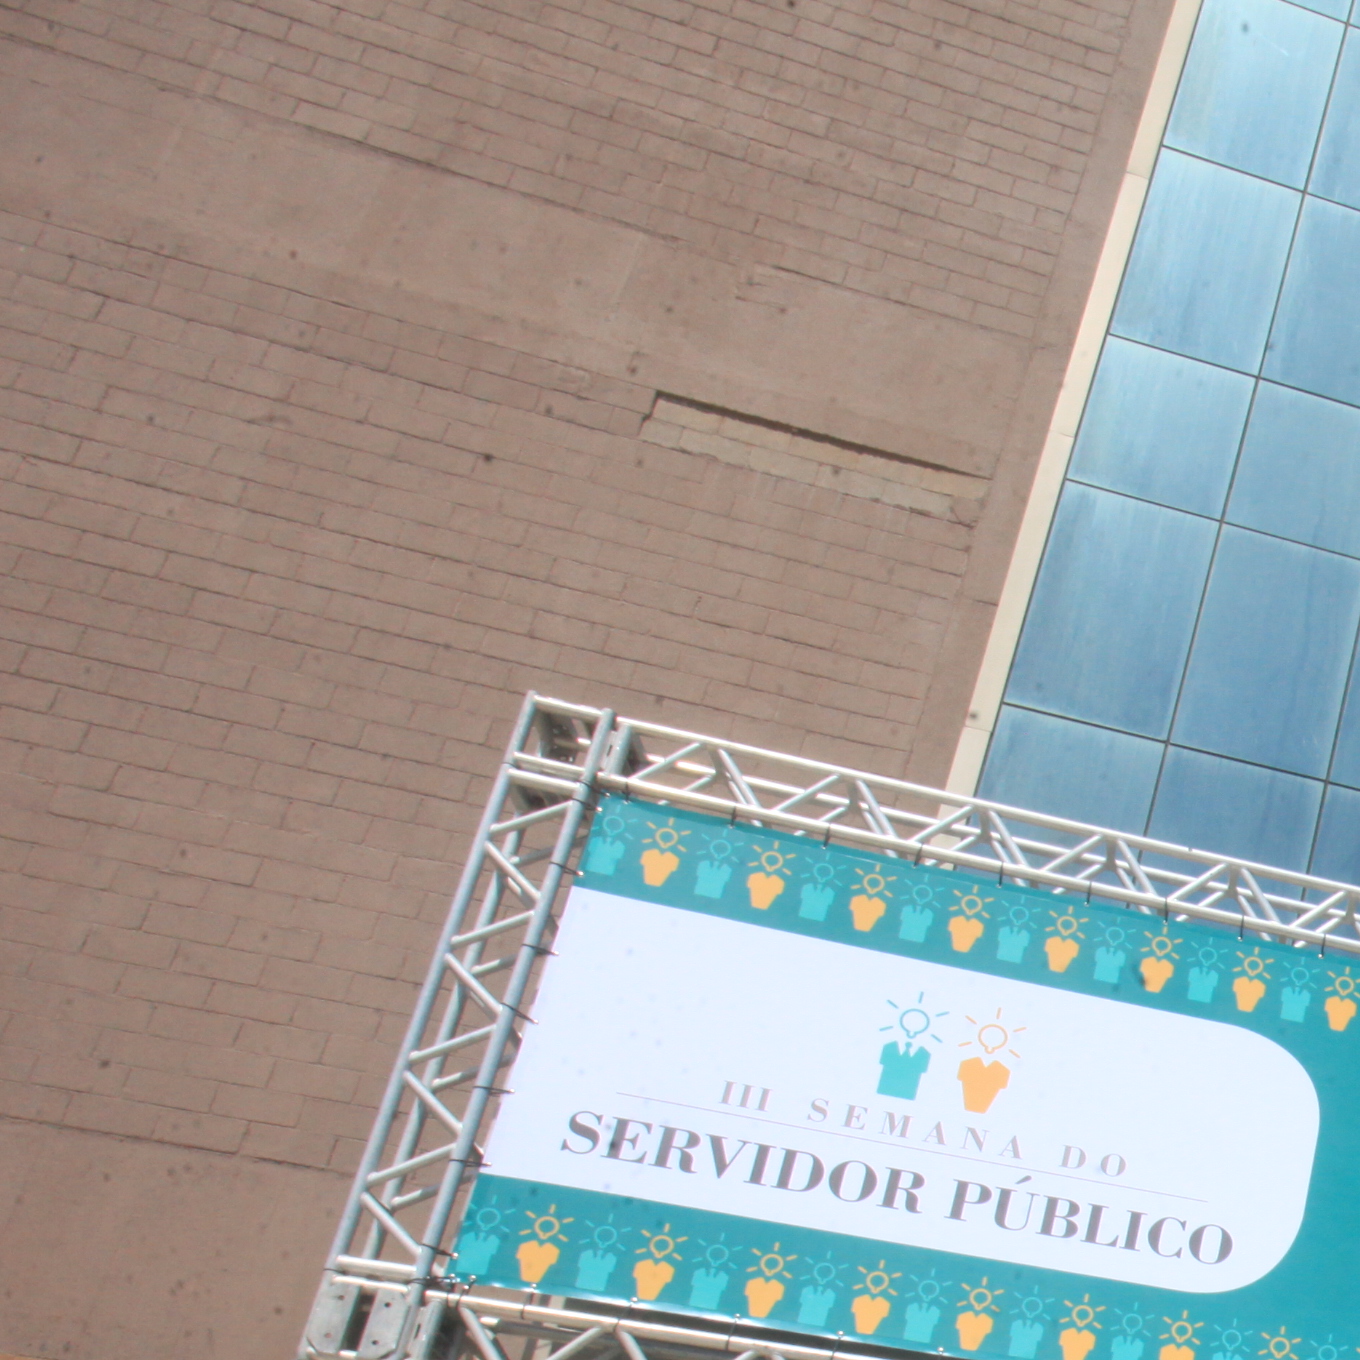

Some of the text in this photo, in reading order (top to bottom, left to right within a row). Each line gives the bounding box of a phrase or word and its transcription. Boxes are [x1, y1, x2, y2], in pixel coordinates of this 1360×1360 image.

[559, 1110, 1234, 1266] SERVIDOR PÚBLICO
[720, 1080, 1129, 1178] III SEMANA DO
